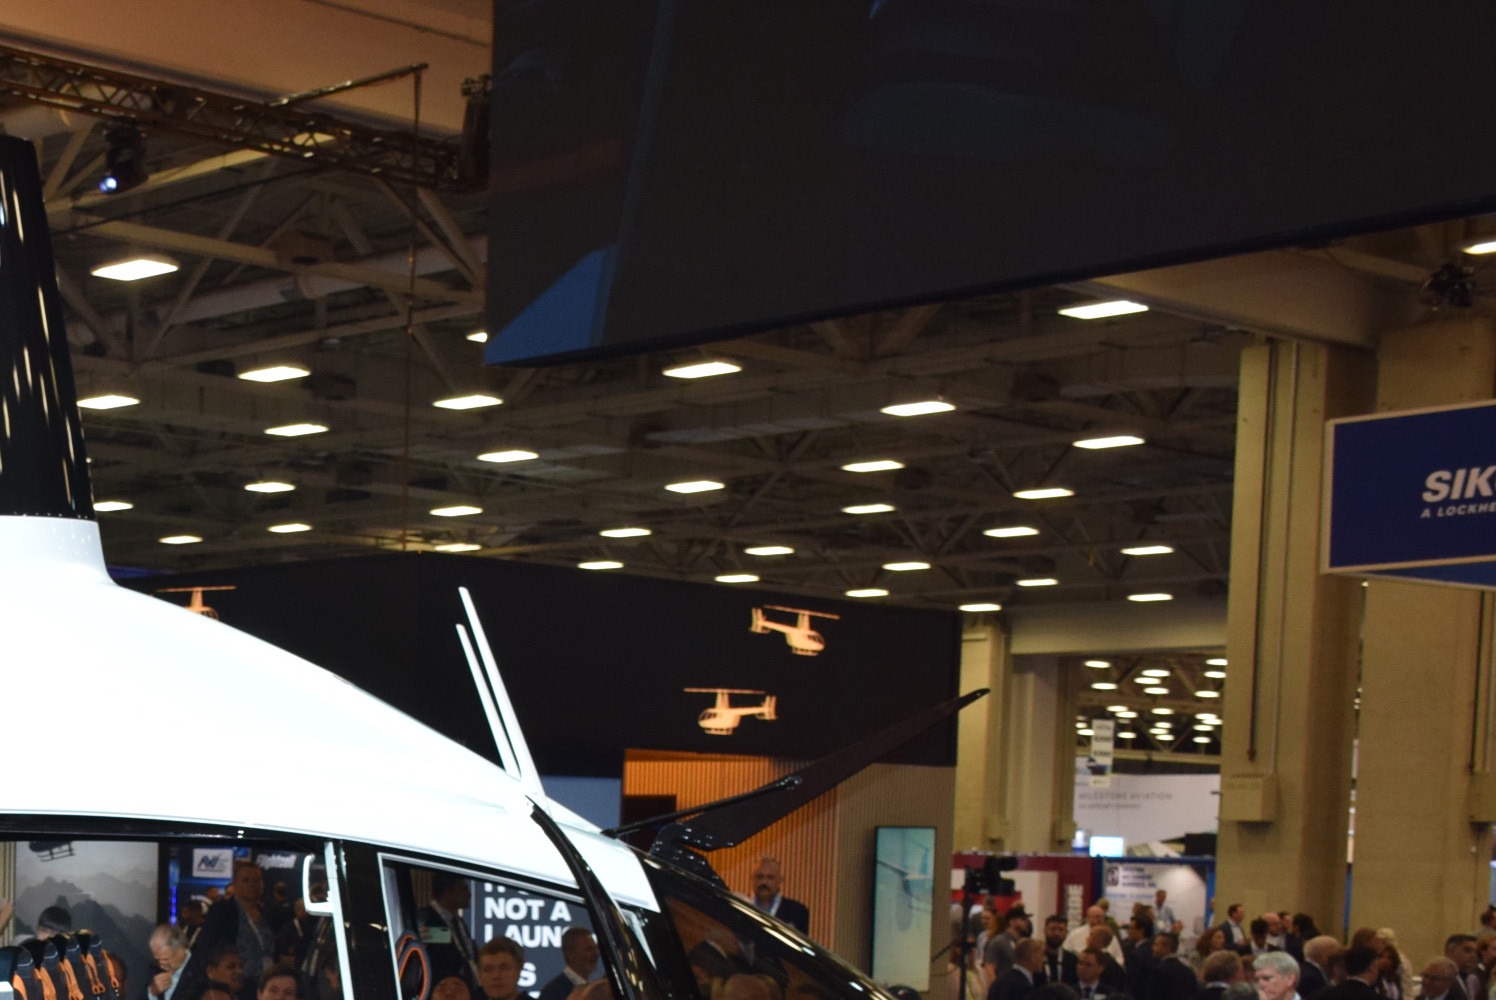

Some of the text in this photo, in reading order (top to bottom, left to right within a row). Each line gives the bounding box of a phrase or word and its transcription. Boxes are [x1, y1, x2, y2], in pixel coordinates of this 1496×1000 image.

[1420, 508, 1431, 519] A
[484, 896, 572, 922] NOT A
[484, 923, 598, 948] LAUN
